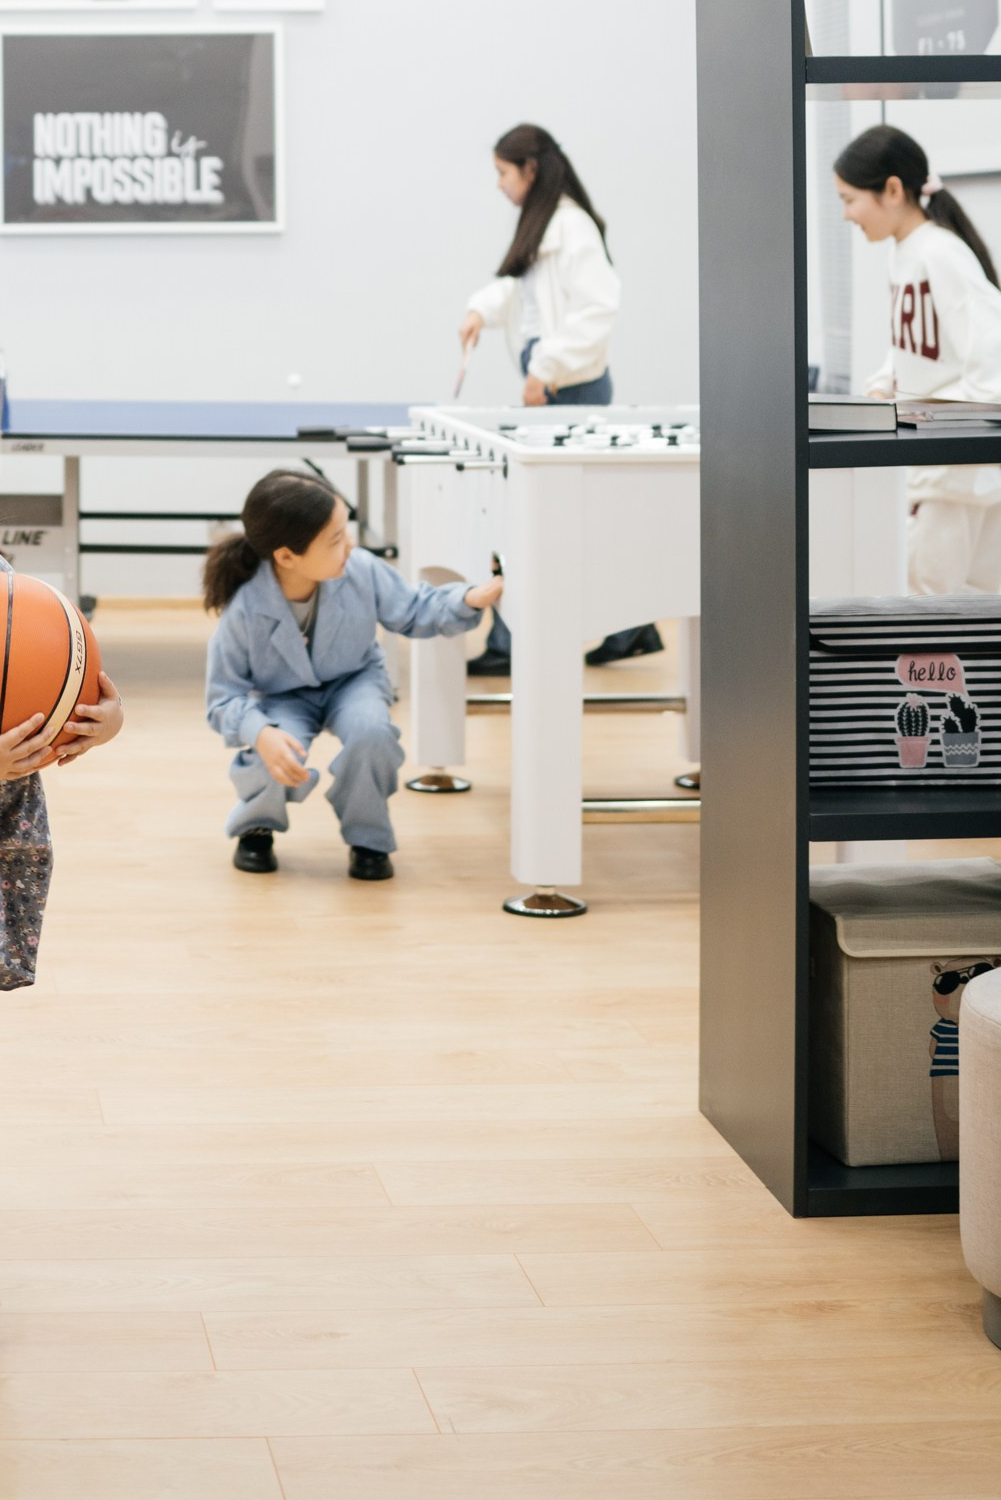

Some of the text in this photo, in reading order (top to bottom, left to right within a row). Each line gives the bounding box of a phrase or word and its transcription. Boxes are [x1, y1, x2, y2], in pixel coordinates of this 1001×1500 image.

[33, 111, 206, 160] NOTHING is
[33, 155, 225, 205] IMPOSSIBLE
[1, 529, 46, 546] LINE
[907, 659, 957, 682] hello
